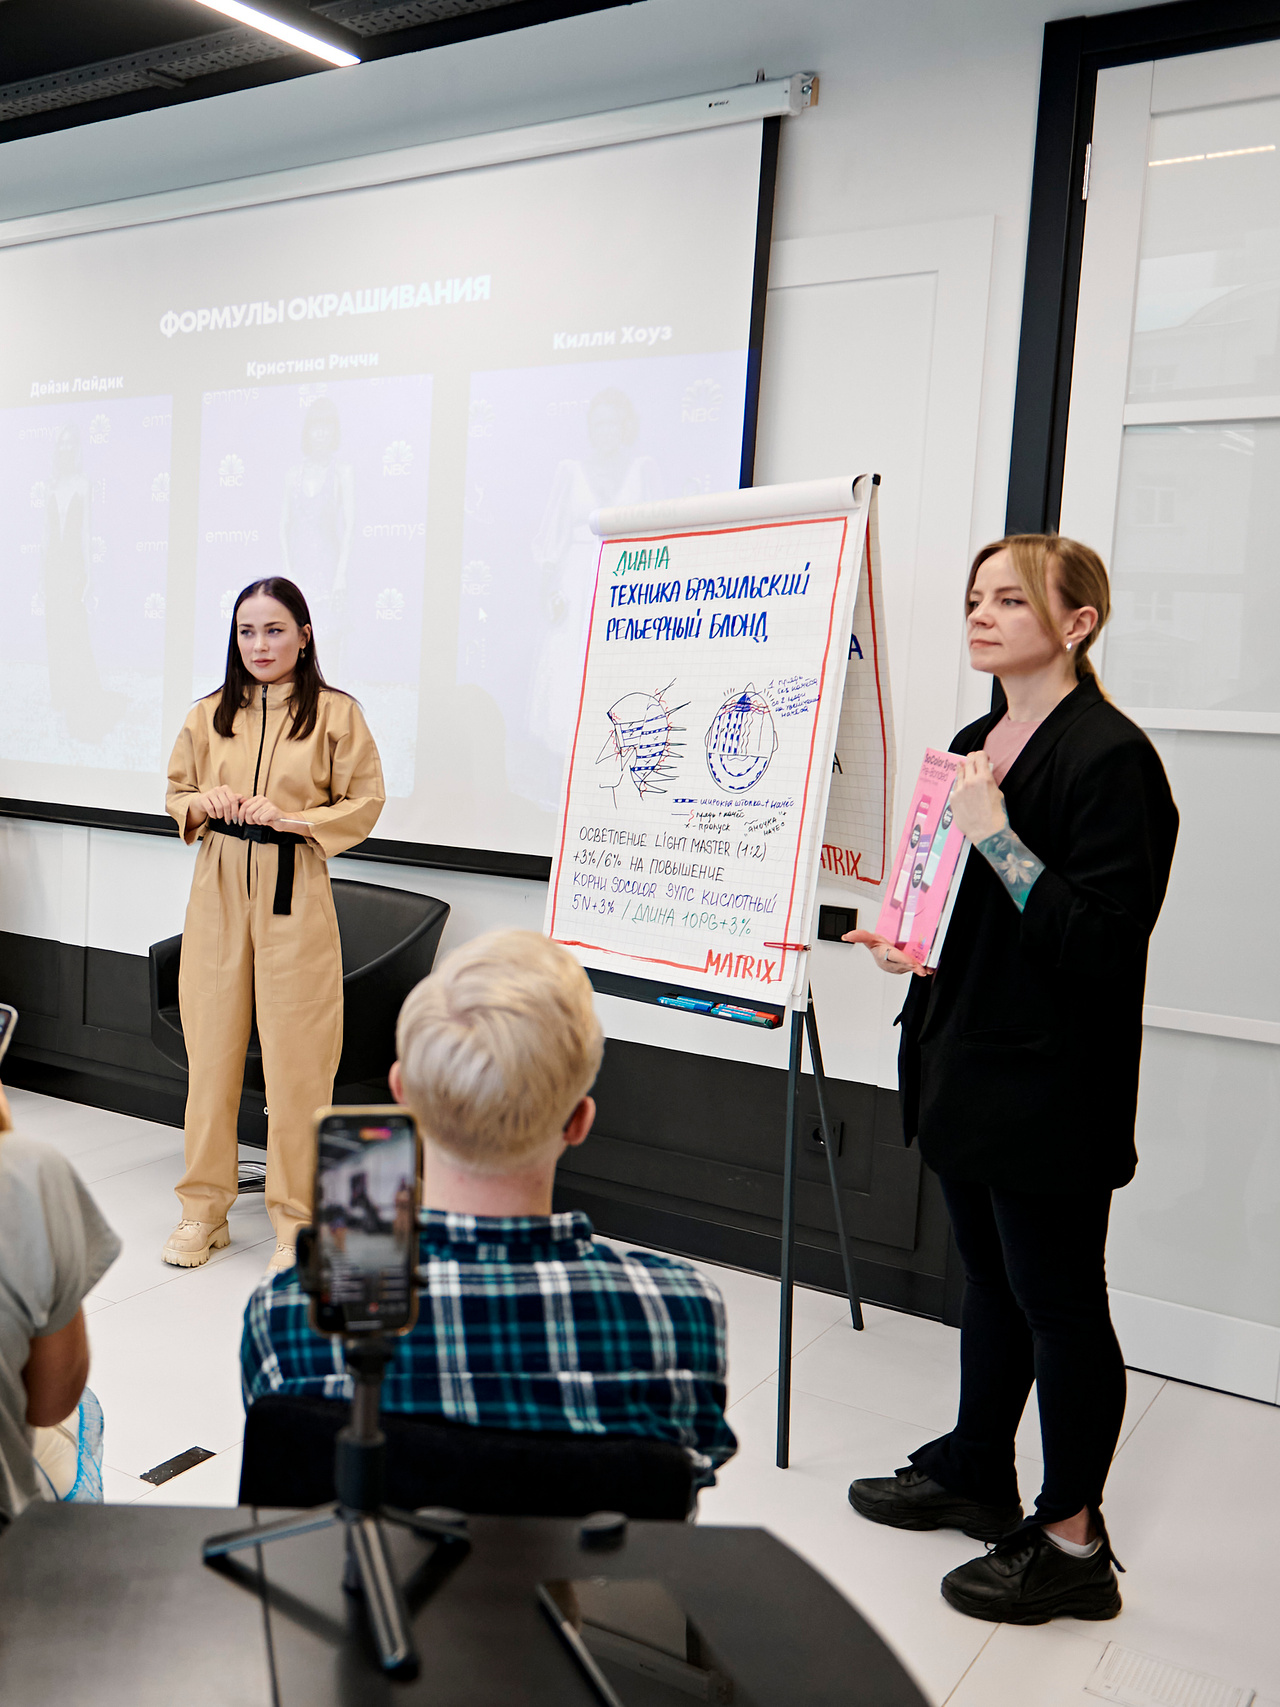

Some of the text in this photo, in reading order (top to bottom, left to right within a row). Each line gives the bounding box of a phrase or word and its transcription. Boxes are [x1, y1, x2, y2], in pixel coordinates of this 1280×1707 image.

[159, 273, 492, 339] ФОРМУЛЫ ОКРАШИВАНИЯ
[552, 325, 673, 350] Килли Хоуз
[246, 352, 379, 379] Кристина Риччи
[29, 375, 124, 398] Дейзи Лайдик
[681, 407, 720, 423] NBC
[382, 462, 412, 477] NBC
[205, 528, 259, 547] emmys
[362, 522, 426, 541] emmys
[612, 545, 671, 576] ДИАНА
[609, 561, 811, 608] ТЕХНИКА БРАЗИЛЬСКИЙ
[376, 608, 404, 620] NBC
[605, 608, 769, 643] РЕЛЬЕФНЫЙ БЛОНД
[579, 826, 648, 848] ОСВЕТЛЕНИЕ
[690, 839, 731, 857] MASTER
[629, 856, 644, 873] НА
[649, 858, 725, 882] ПОВЫШЕНИЕ
[572, 871, 607, 891] КОРНИ
[701, 889, 778, 914] КИСЛОТНЫЙ
[631, 903, 675, 927] ДЛИНА
[706, 948, 776, 984] MATRIX
